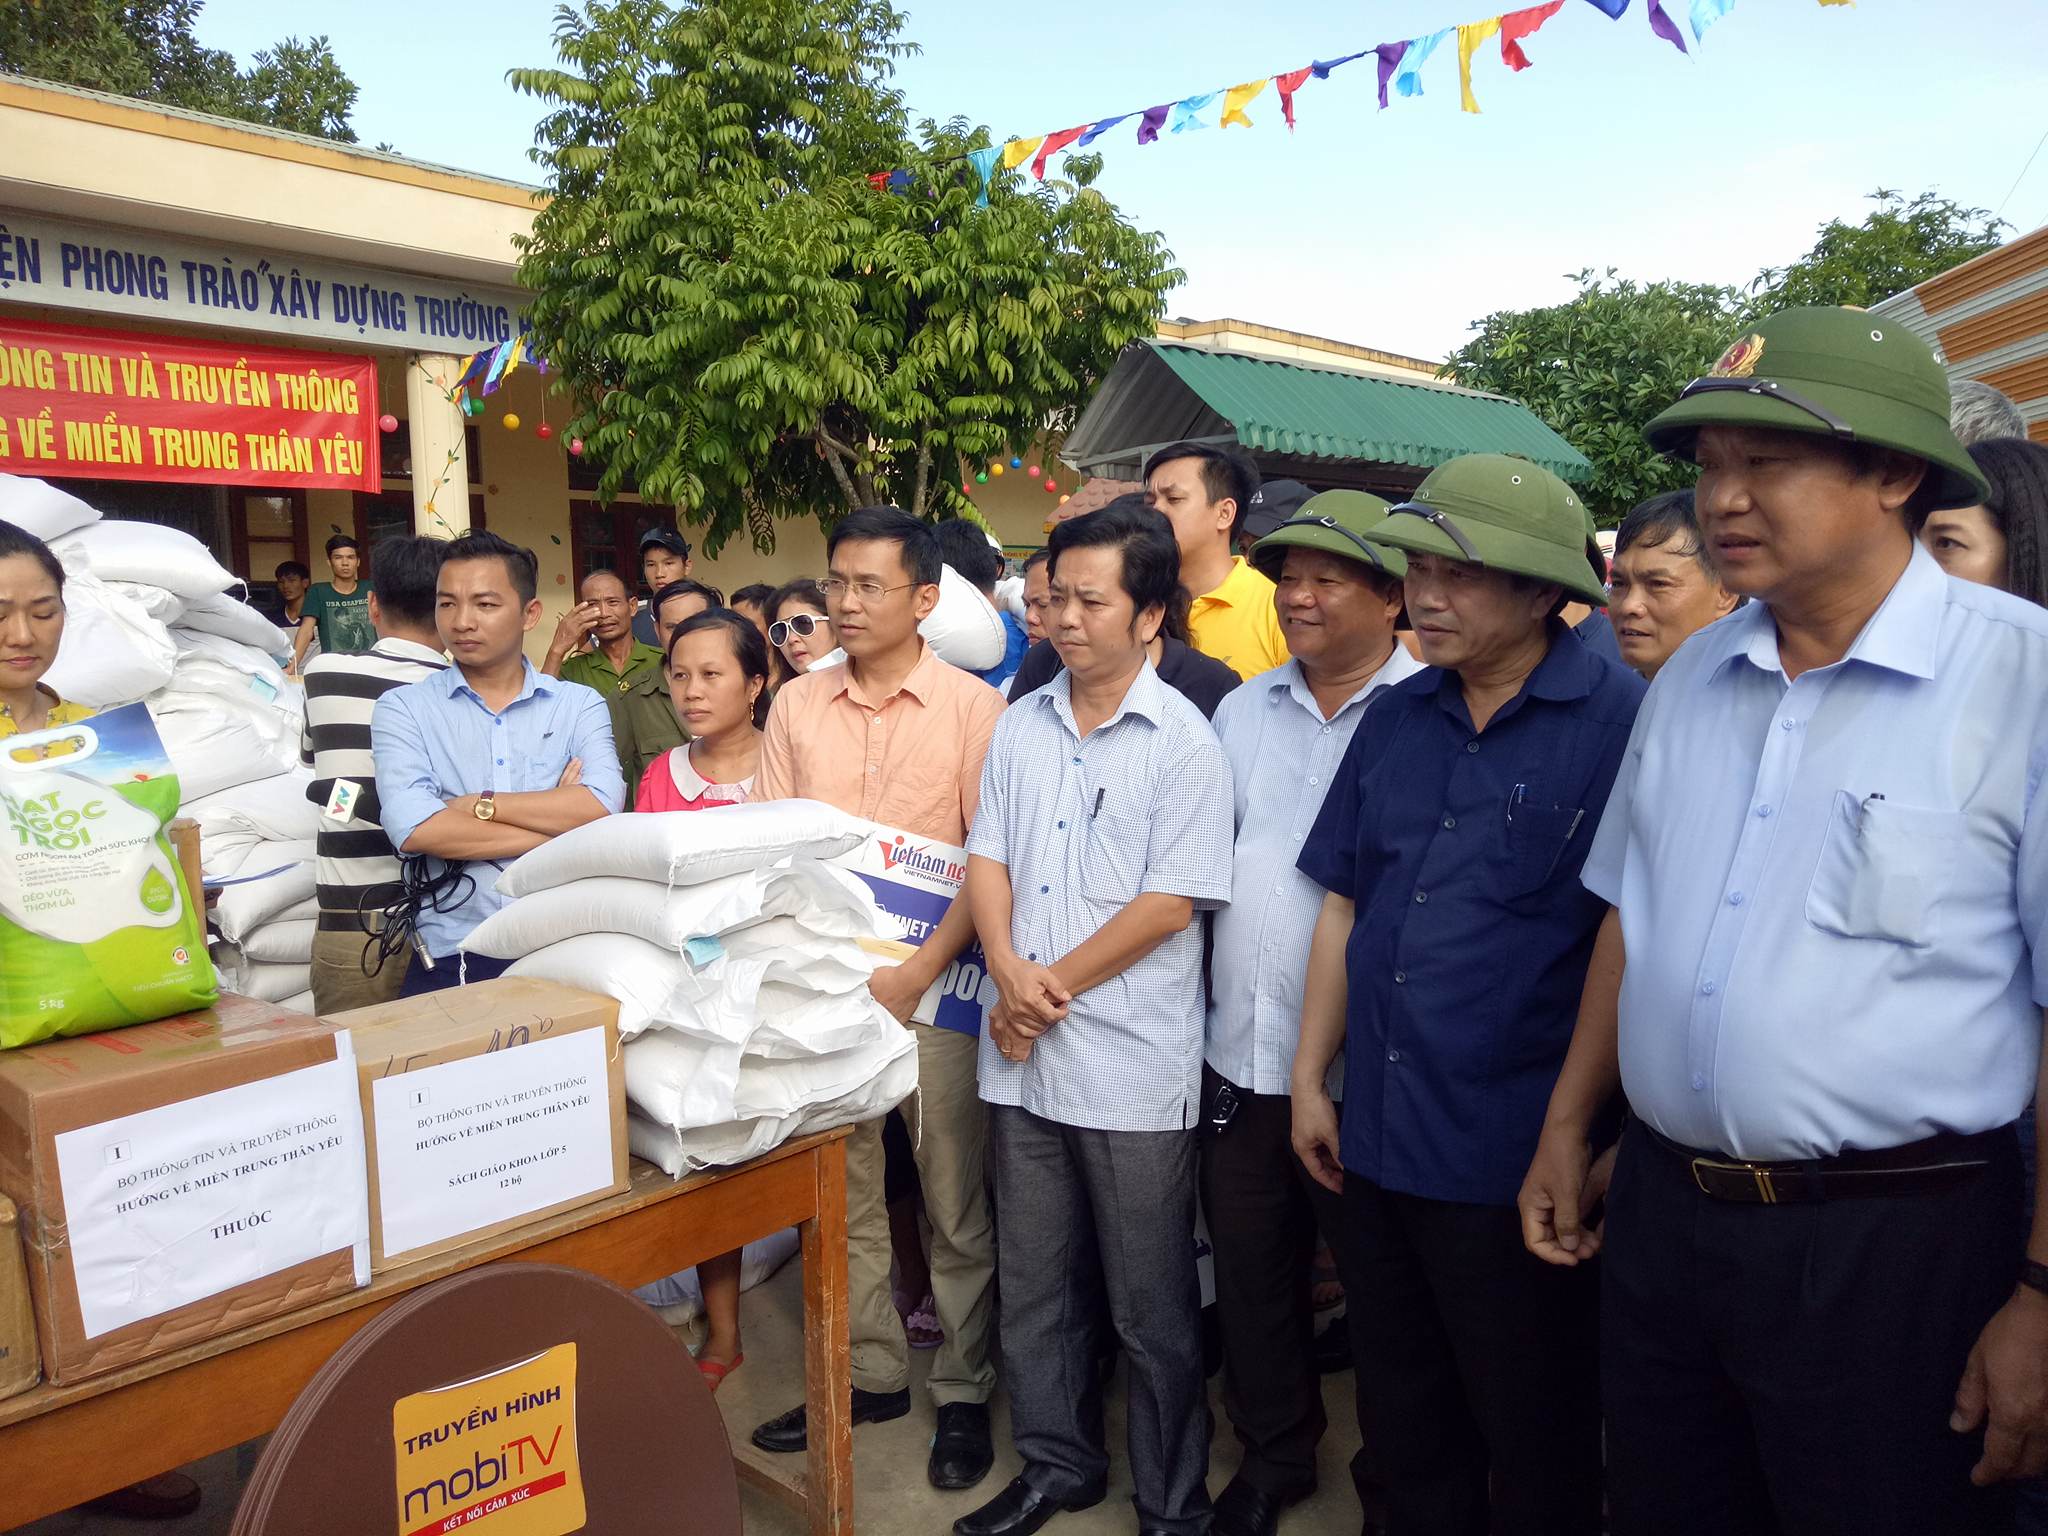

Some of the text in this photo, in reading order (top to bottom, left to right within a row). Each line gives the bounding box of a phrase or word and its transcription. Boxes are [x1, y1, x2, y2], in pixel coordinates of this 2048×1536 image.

[61, 243, 168, 301] PHONG
[181, 257, 259, 311] TRÀO
[333, 283, 407, 334] DỰNG
[415, 292, 510, 342] TRƯỜNG
[62, 352, 113, 395] TIN
[119, 352, 160, 399] VÀ
[165, 357, 271, 407] TRUYỀN
[275, 369, 359, 414] THÔNG
[17, 406, 56, 459] VỀ
[64, 411, 142, 464] MIỀN
[149, 427, 239, 470] TRUNG
[246, 428, 313, 473] THÂN
[319, 432, 362, 475] YÊU
[904, 868, 961, 889] VIETNAMNET.V
[474, 1101, 493, 1115] TIN
[494, 1093, 510, 1107] VÀ
[553, 1076, 587, 1092] THÔNG
[505, 1109, 540, 1126] TRUNG
[571, 1095, 591, 1108] YÊU
[190, 1151, 214, 1166] TIN
[218, 1141, 236, 1157] VÀ
[294, 1114, 338, 1135] THÔNG
[232, 1156, 279, 1177] TRUNG
[280, 1141, 316, 1164] THÂN
[318, 1135, 344, 1151] YÊU
[448, 1145, 567, 1188] SÁCH GIÁO KHOA LỚP 5
[500, 1175, 522, 1189] 12 bộ
[404, 1385, 561, 1455] TRUYỀN HÌNH
[404, 1424, 563, 1523] mobiTV
[443, 1488, 530, 1532] KẾT NỐI CẢM XÚC
